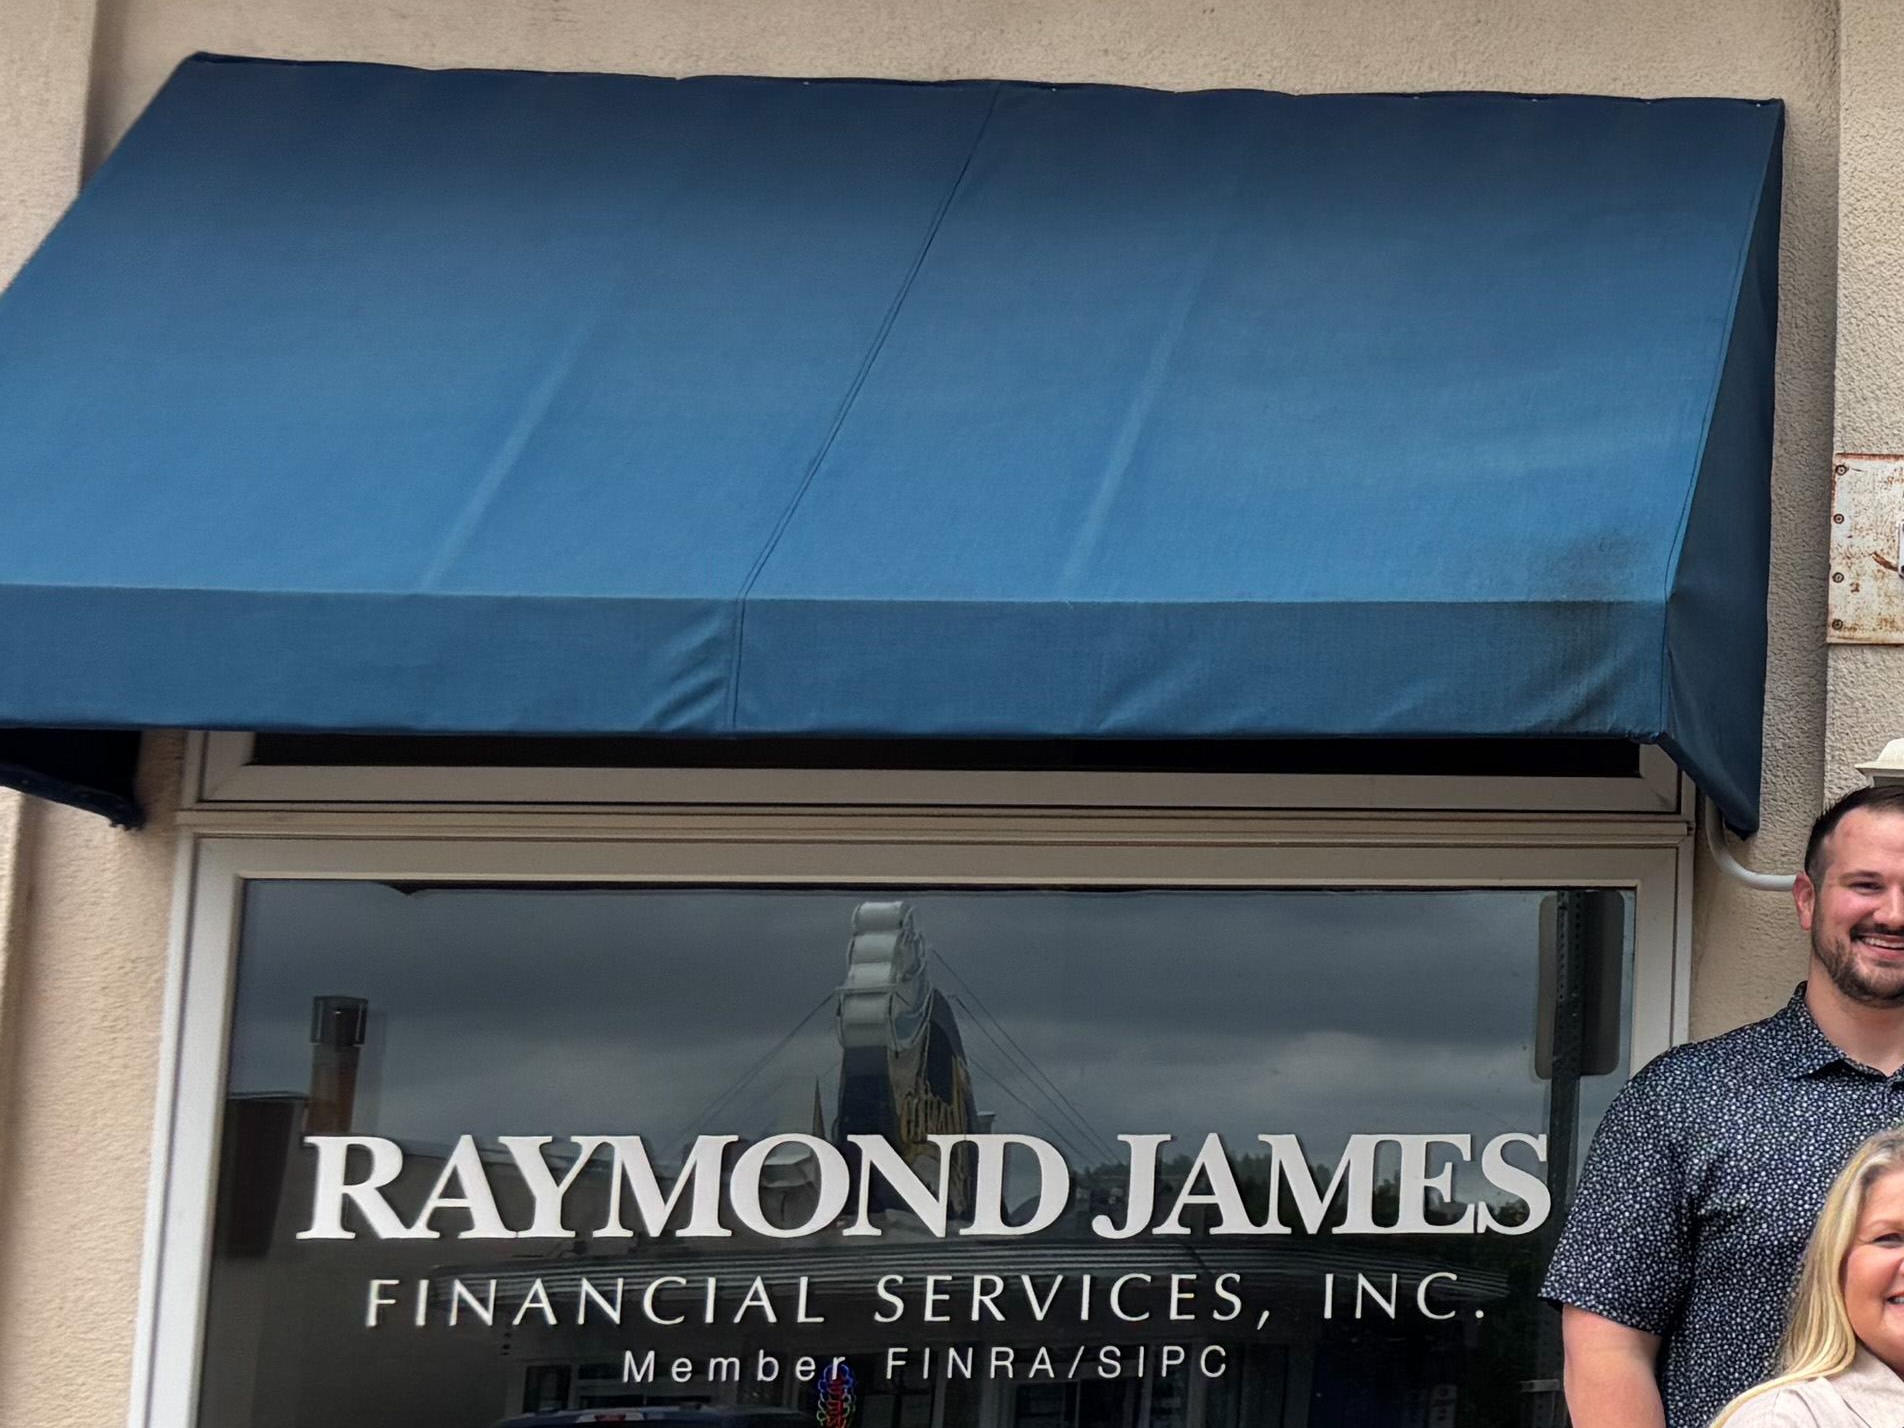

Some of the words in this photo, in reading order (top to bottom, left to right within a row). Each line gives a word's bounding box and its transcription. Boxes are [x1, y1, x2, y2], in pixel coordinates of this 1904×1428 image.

[296, 1132, 1070, 1240] RAYMOND
[1091, 1131, 1551, 1239] JAMES
[366, 1275, 826, 1328] FINANCIAL
[874, 1272, 1271, 1331] SERVICES,
[1323, 1271, 1486, 1321] INC.
[622, 1348, 848, 1384] Member
[885, 1344, 1229, 1381] FINRA/SIPC
